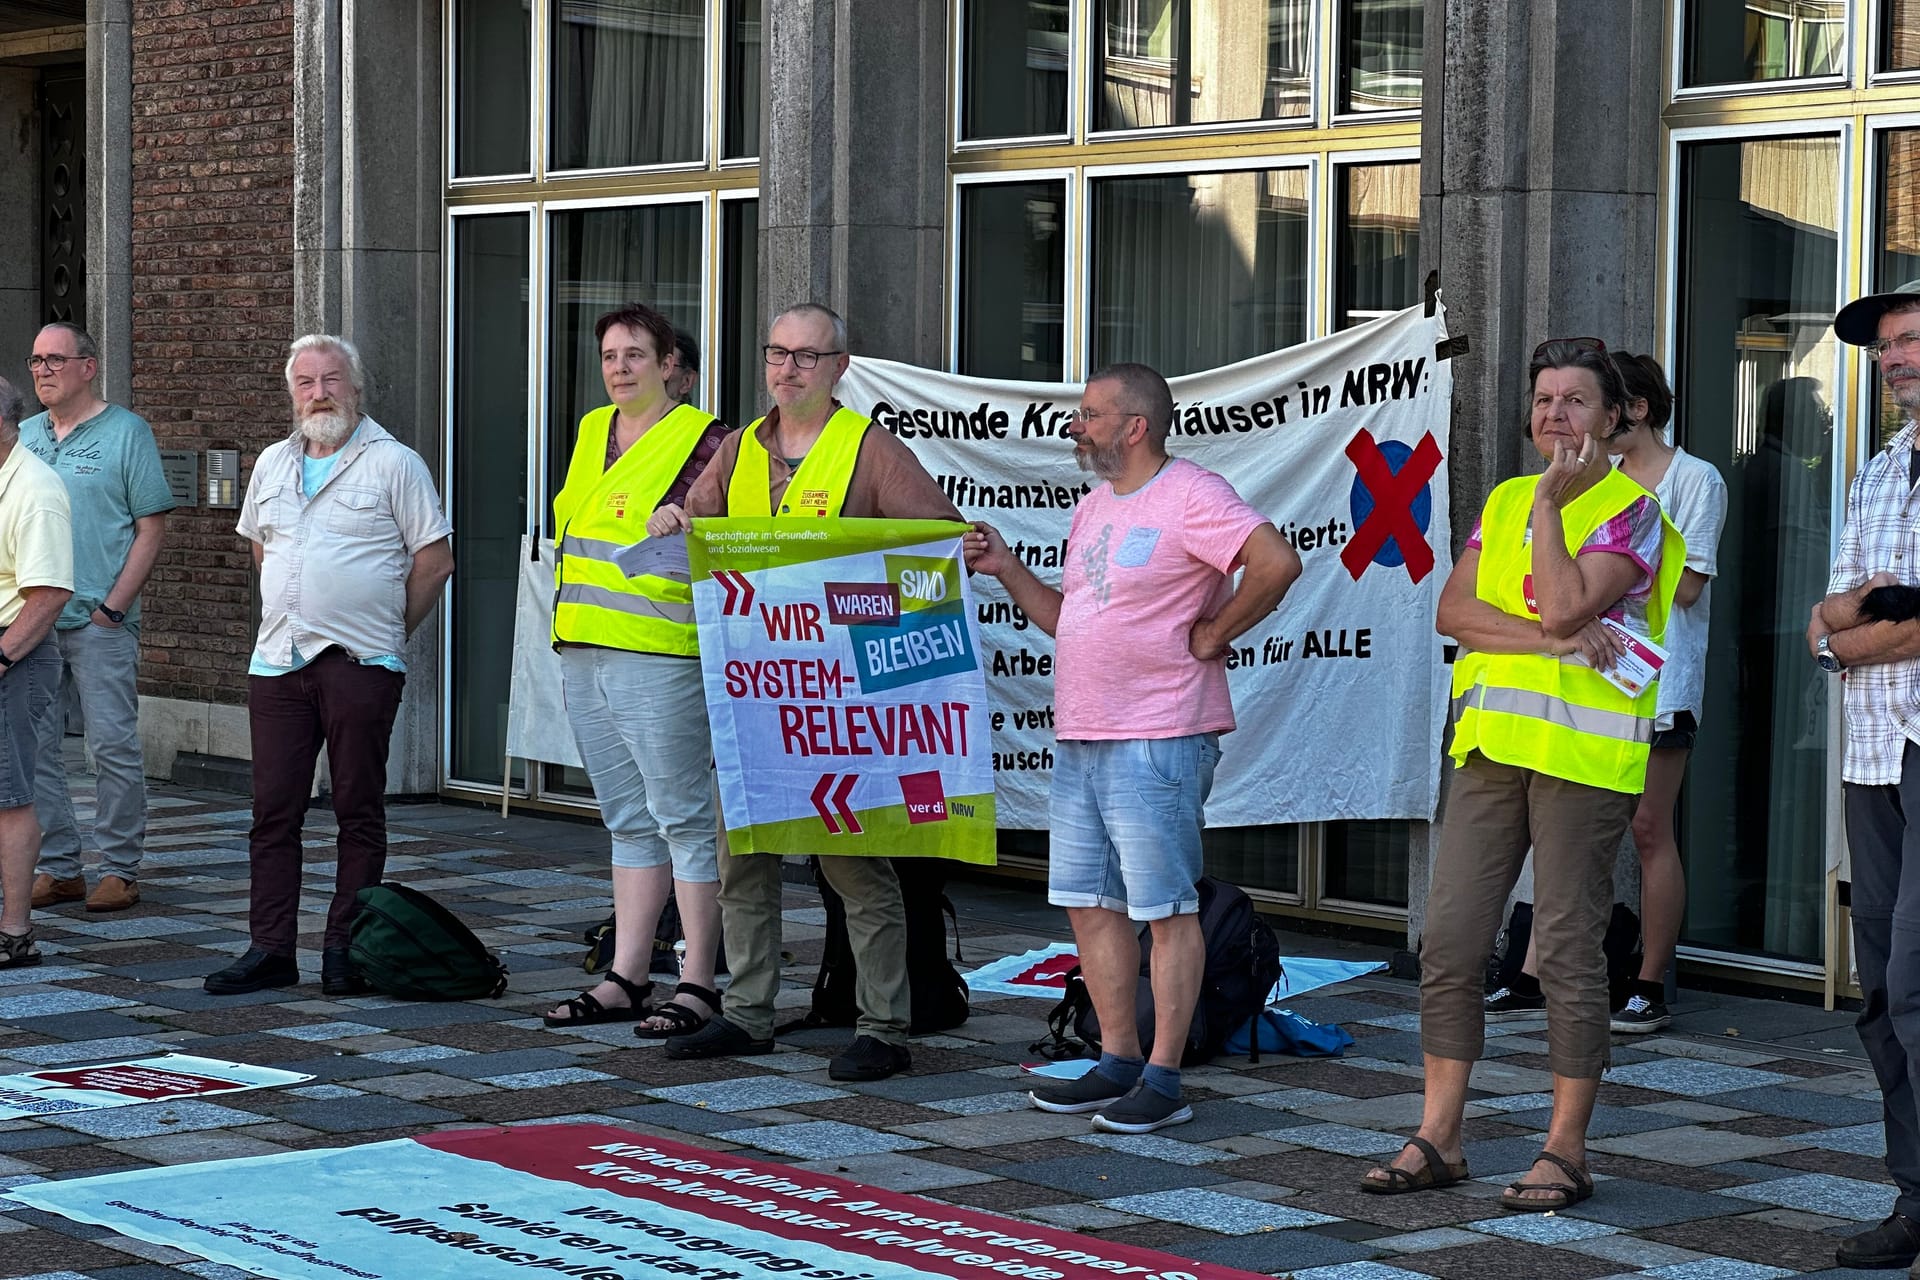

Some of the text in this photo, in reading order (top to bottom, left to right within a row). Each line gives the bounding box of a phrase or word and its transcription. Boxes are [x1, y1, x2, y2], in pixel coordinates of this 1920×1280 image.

[871, 401, 1009, 440] Gesunde
[1297, 381, 1331, 418] in
[1340, 357, 1429, 408] NRW:
[705, 530, 832, 544] Beschäftigte im Gesundheits-
[708, 544, 780, 554] und Sozialwesen
[900, 569, 946, 602] SIND
[759, 593, 895, 643] WIR WAREN
[864, 619, 965, 677] BLEIBEN
[1263, 636, 1294, 665] für
[1302, 628, 1371, 659] ALLE
[724, 658, 855, 700] SYSTEM-
[778, 702, 970, 757] RELEVANT
[950, 802, 975, 818] NRW
[575, 1161, 850, 1229] Krankenhaus
[438, 1203, 628, 1254] Sanieren
[561, 1206, 816, 1274] Versorgung
[827, 1200, 1151, 1276] Amsterdamer
